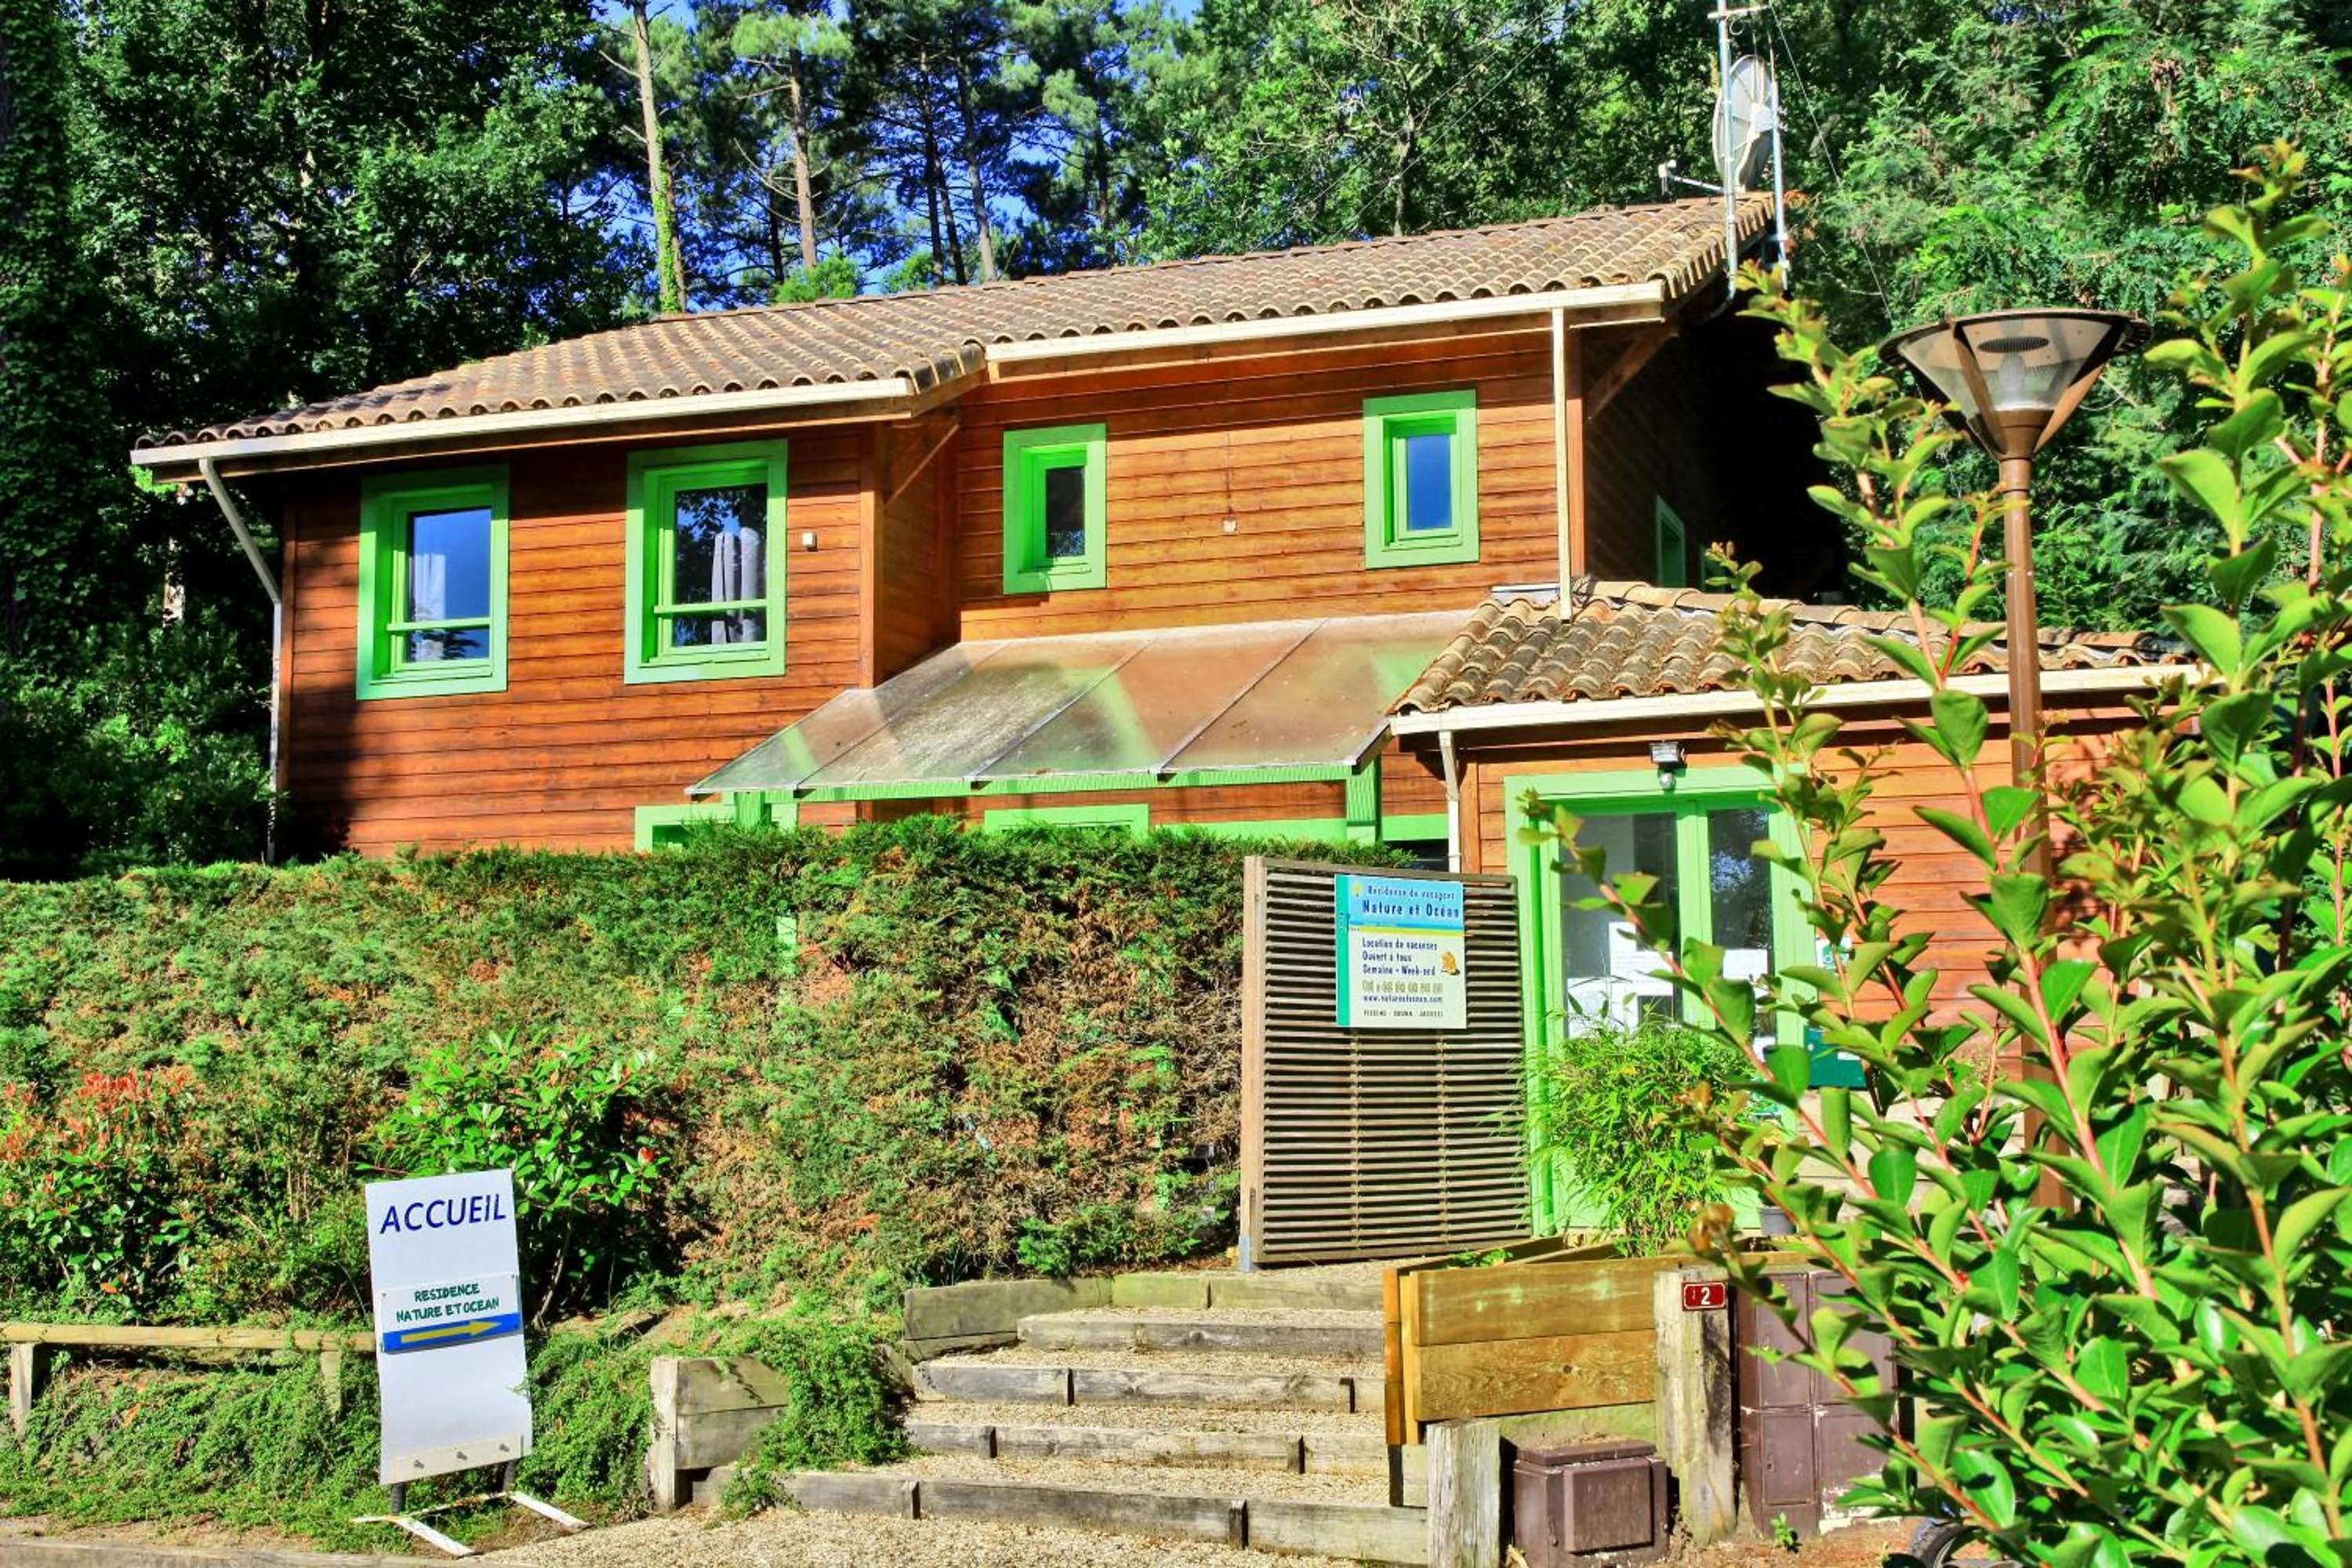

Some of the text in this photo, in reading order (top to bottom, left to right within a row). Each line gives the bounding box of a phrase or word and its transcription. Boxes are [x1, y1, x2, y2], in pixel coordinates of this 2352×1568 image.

[1363, 899, 1459, 918] Nature et Océan
[1362, 937, 1437, 951] Location de vacances
[1363, 950, 1387, 961] Ouvert
[1396, 953, 1412, 962] tous
[1363, 964, 1393, 975] Semaine
[1401, 964, 1436, 975] Week-end
[379, 1193, 506, 1234] ACCUEIL
[414, 1283, 480, 1302] RESIDENCE
[1700, 1287, 1711, 1305] 2
[396, 1297, 499, 1323] NATURE ET OCEAN
